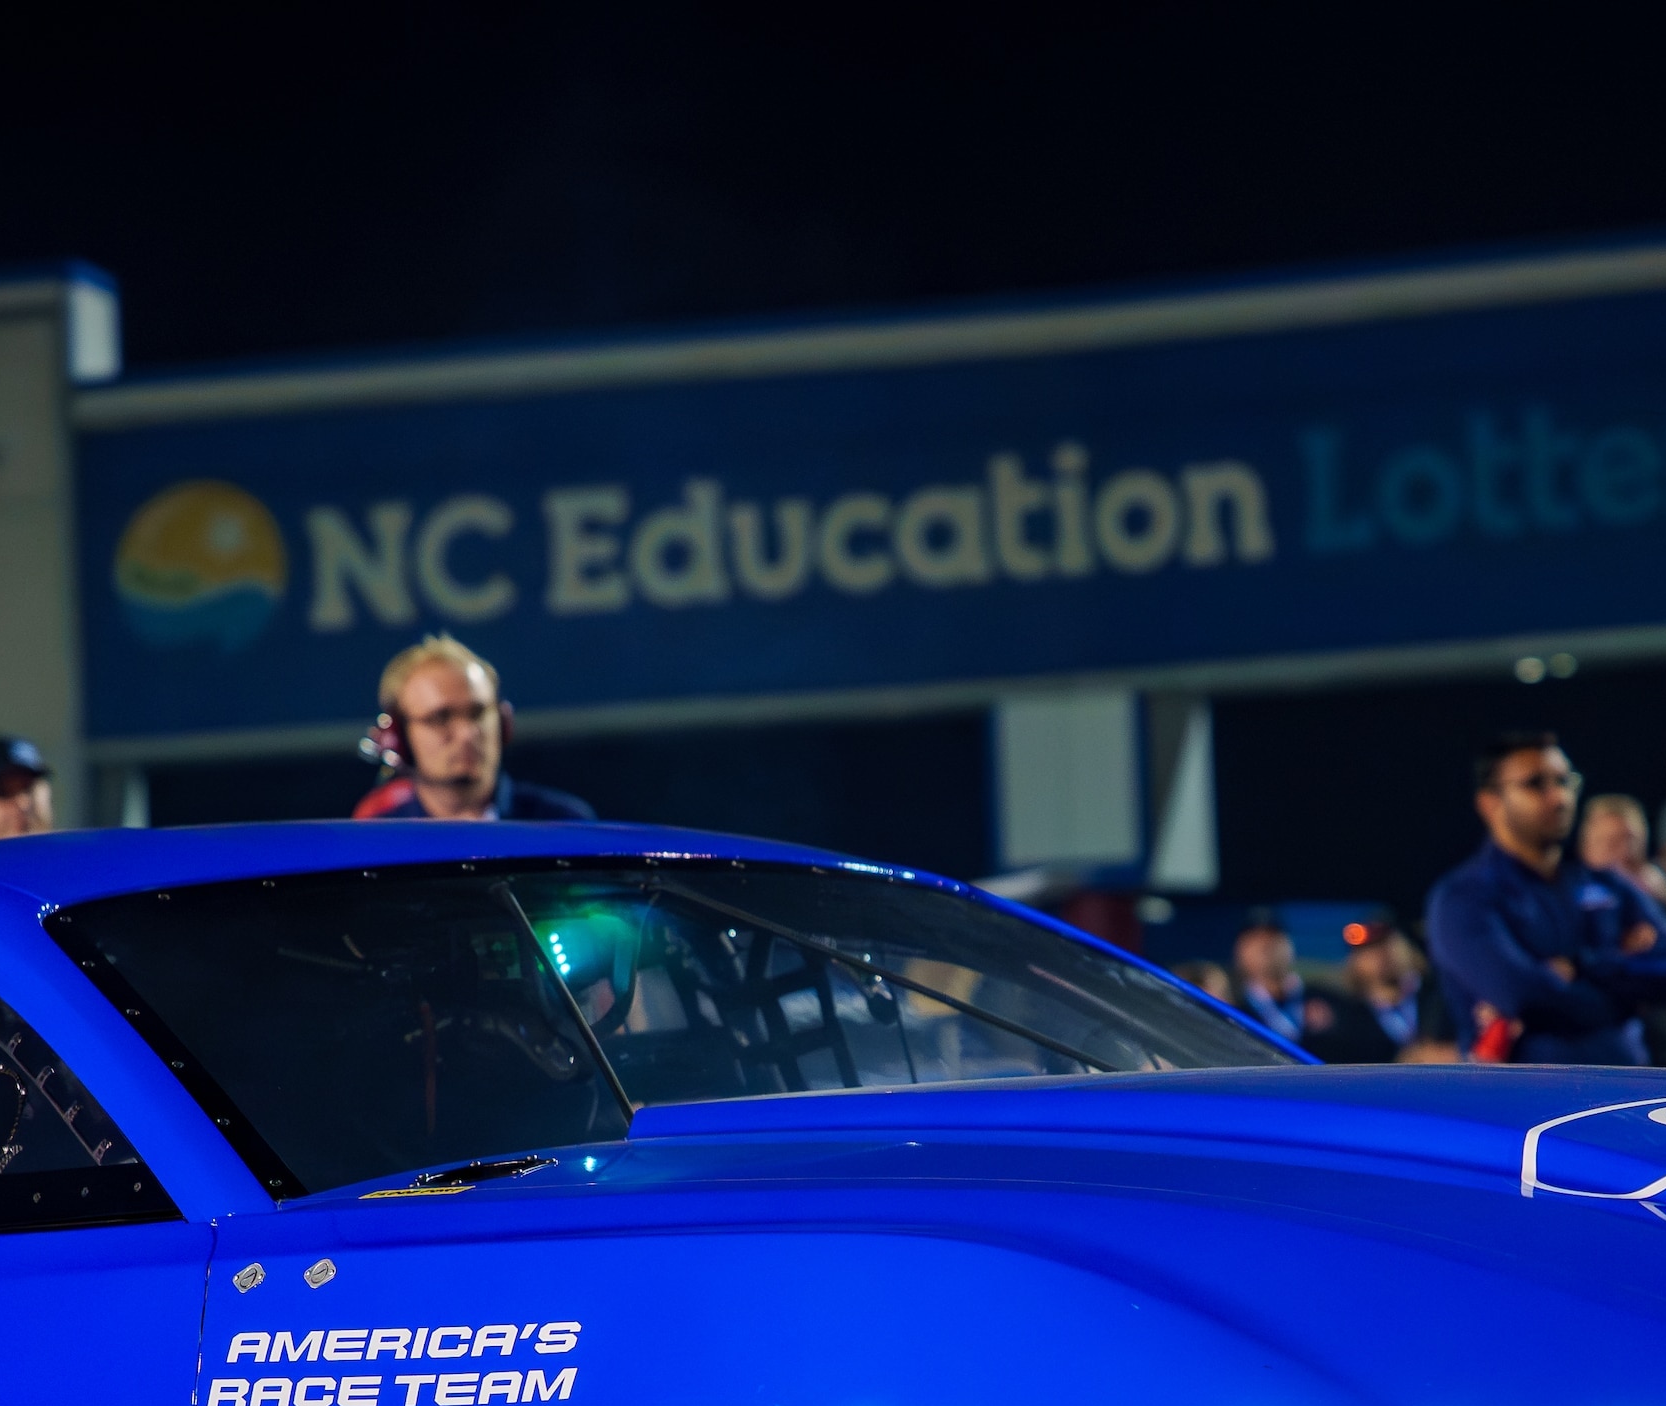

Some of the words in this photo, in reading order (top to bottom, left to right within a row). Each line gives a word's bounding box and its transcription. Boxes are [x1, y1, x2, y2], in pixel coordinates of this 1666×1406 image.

[305, 494, 514, 631] NC
[545, 443, 1274, 614] Education
[226, 1321, 582, 1364] AMERICA'S
